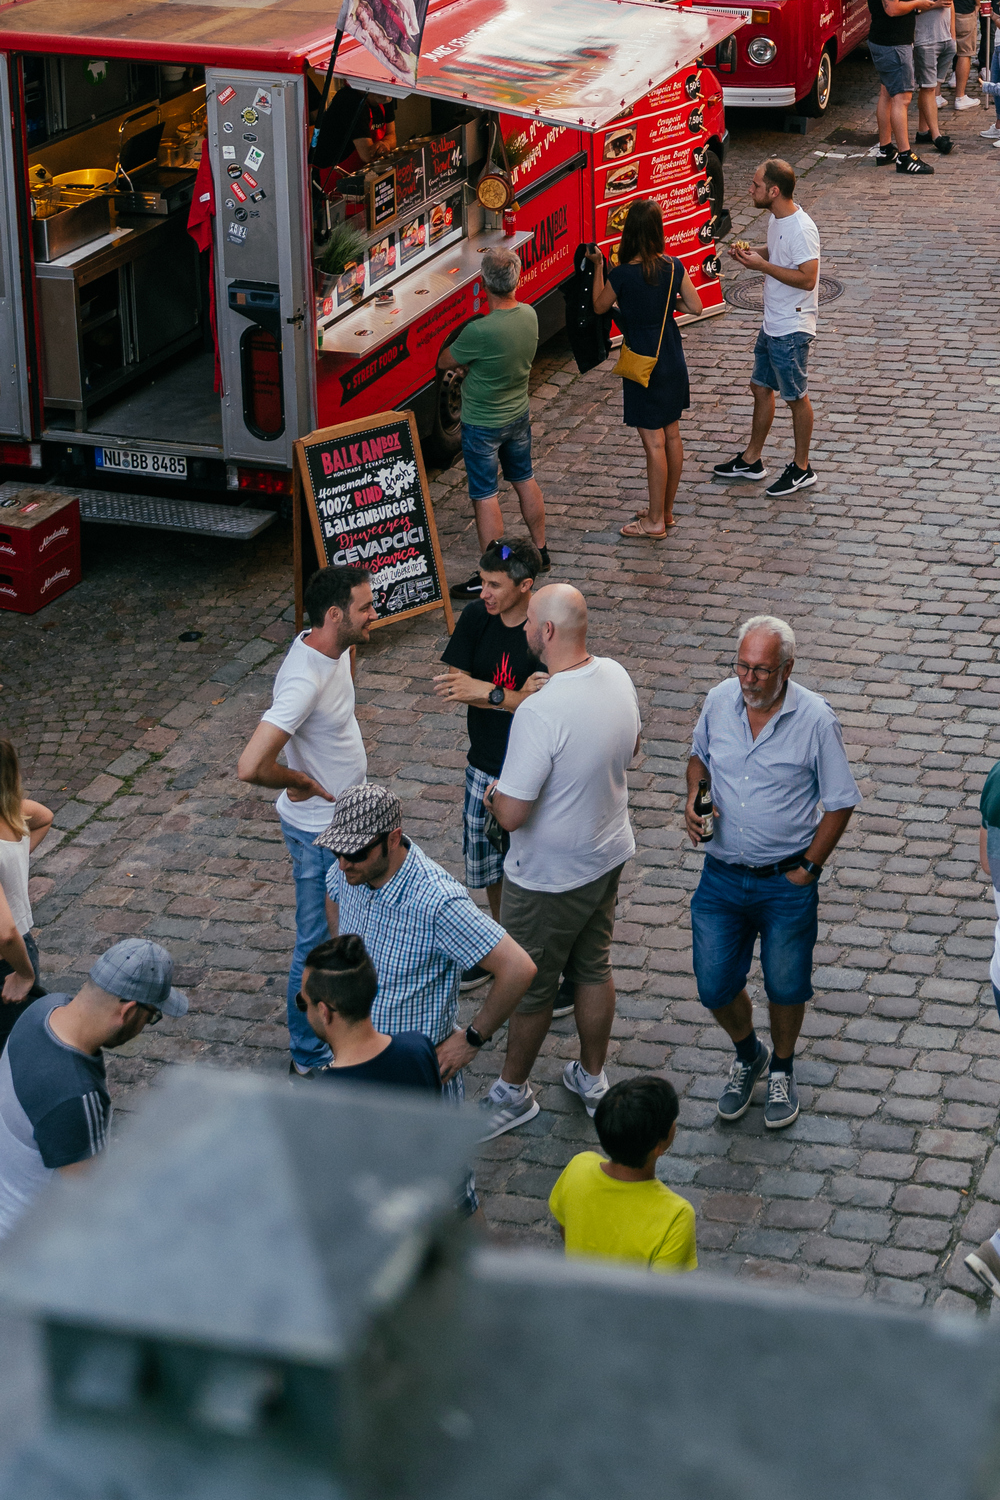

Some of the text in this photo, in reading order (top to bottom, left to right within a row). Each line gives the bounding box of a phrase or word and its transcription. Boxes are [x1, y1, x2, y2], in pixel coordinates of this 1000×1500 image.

[421, 44, 458, 62] MAKE
[673, 81, 682, 91] Box
[651, 147, 691, 165] Balkan Burger
[700, 225, 712, 238] 4€
[540, 244, 569, 273] CEVAPCICI
[706, 261, 718, 274] 4€
[352, 348, 398, 389] STREET FOOD
[104, 450, 186, 474] NU BB 8485
[333, 457, 396, 479] HOMEMADE CEVAPCICI
[318, 466, 411, 499] Homemade fresh
[319, 485, 383, 518] 100% RIND
[333, 526, 425, 566] CEVAPCICI
[40, 567, 71, 594] Almdudler
[370, 561, 423, 587] RISCH ZUBEREITET
